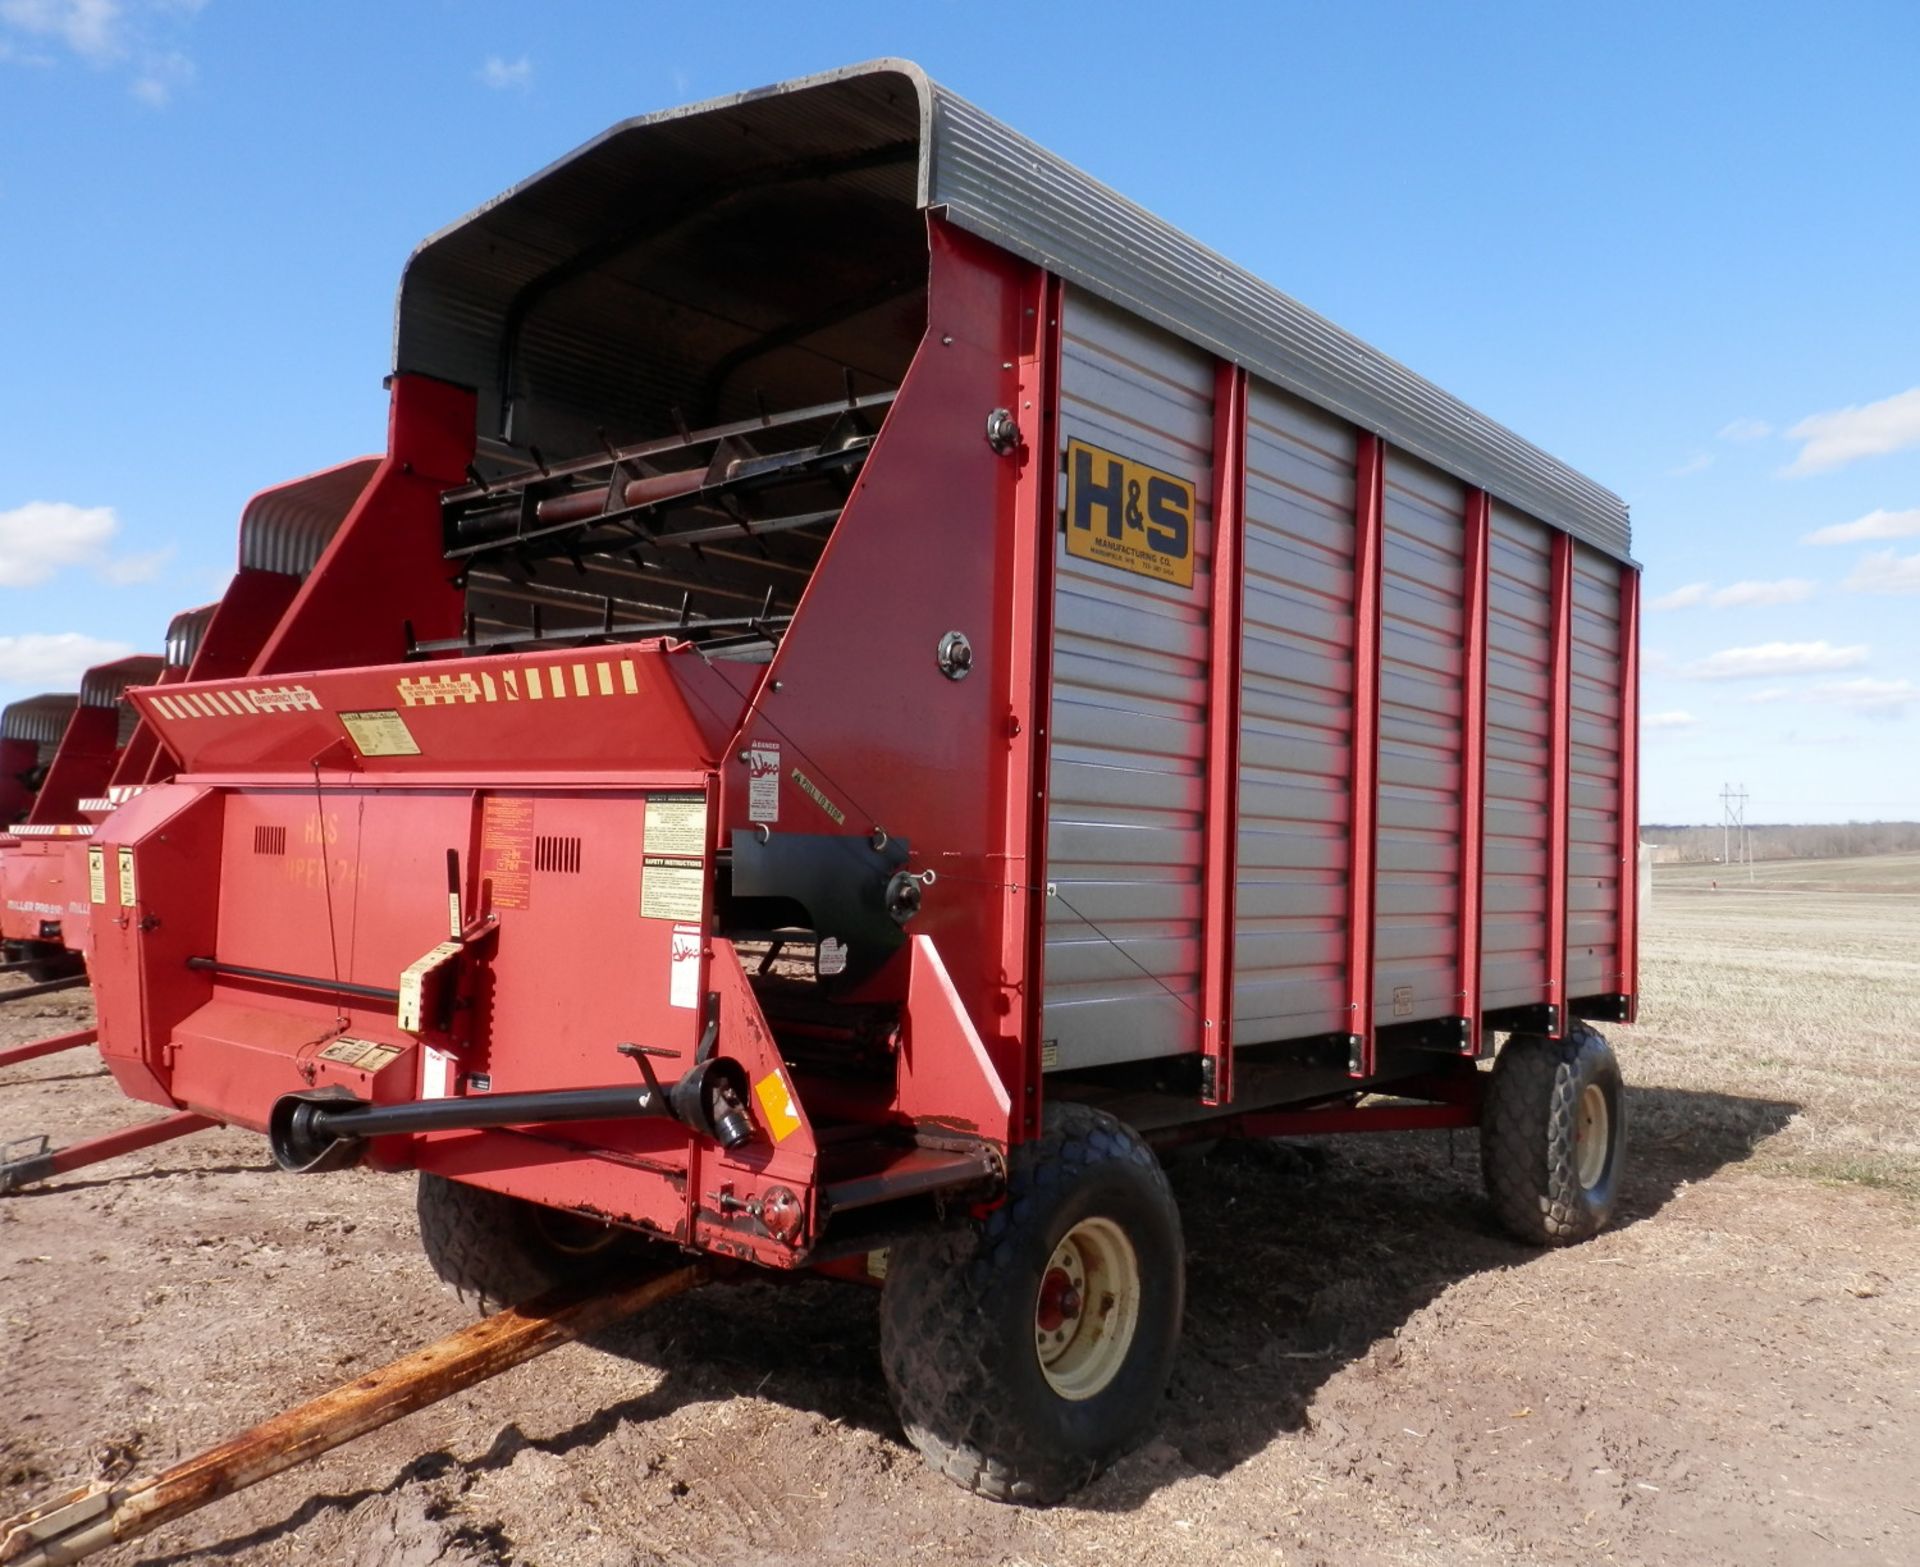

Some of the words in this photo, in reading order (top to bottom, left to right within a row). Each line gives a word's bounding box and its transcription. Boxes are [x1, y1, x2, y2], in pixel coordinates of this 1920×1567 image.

[1074, 448, 1189, 559] H&S
[1095, 536, 1158, 563] MANUFACTURING
[1160, 556, 1171, 567] CO.
